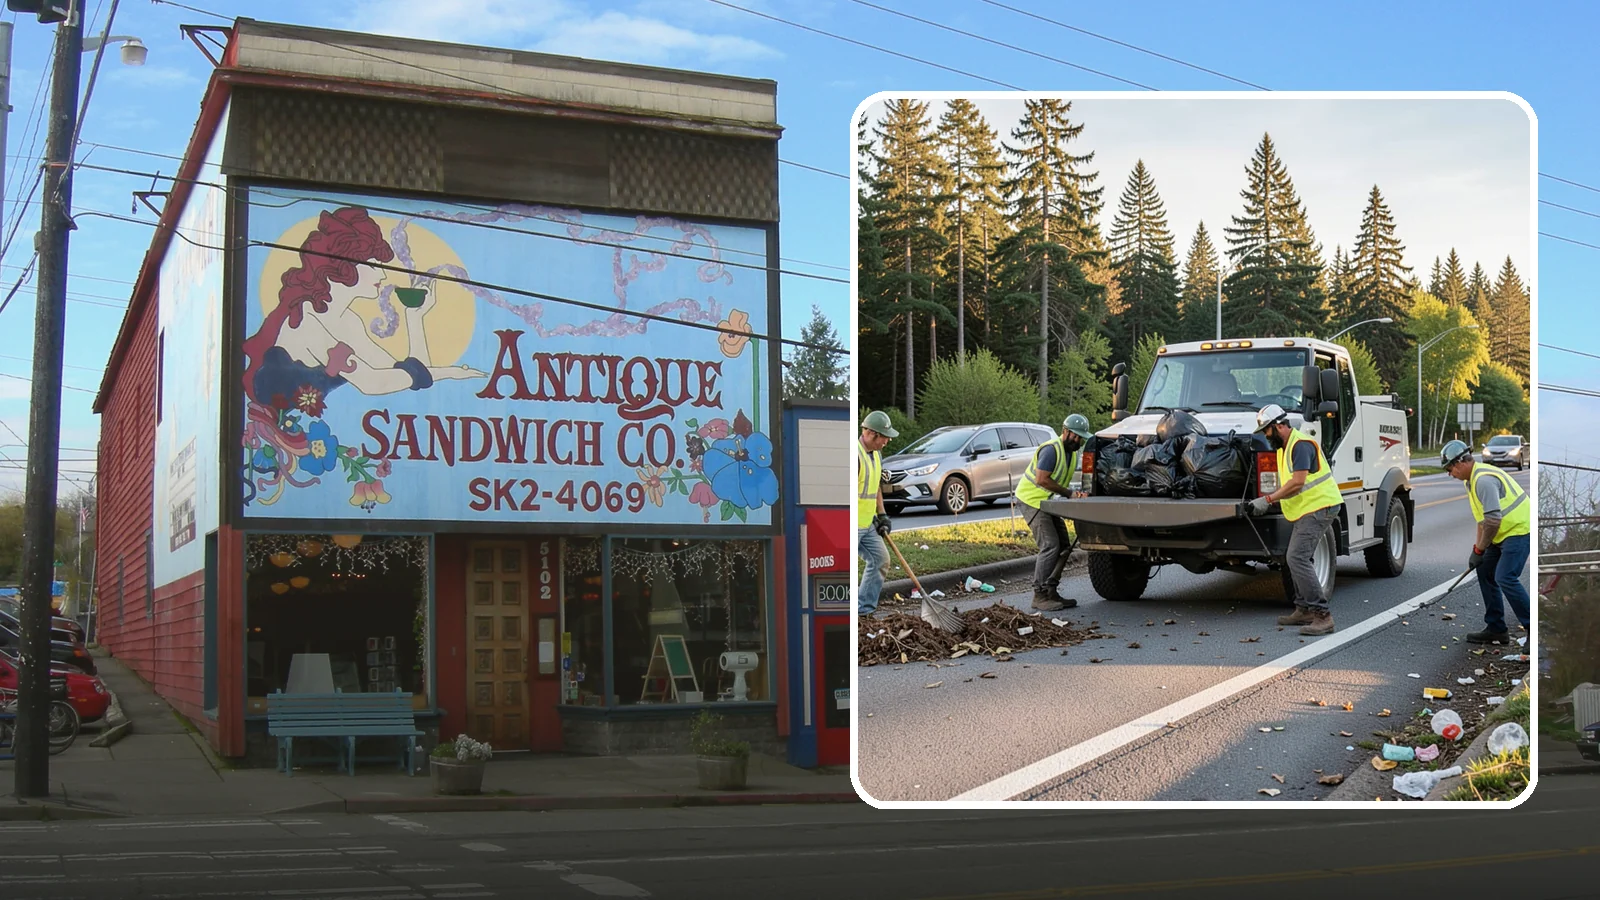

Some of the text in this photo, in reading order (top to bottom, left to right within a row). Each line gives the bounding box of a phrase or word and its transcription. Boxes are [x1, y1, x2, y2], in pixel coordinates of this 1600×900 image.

[475, 329, 724, 421] ANTIQUE
[362, 408, 685, 469] SANDWICH CO.
[469, 477, 645, 513] SK2-4069
[540, 541, 552, 600] 5102
[809, 555, 835, 569] BOOKS
